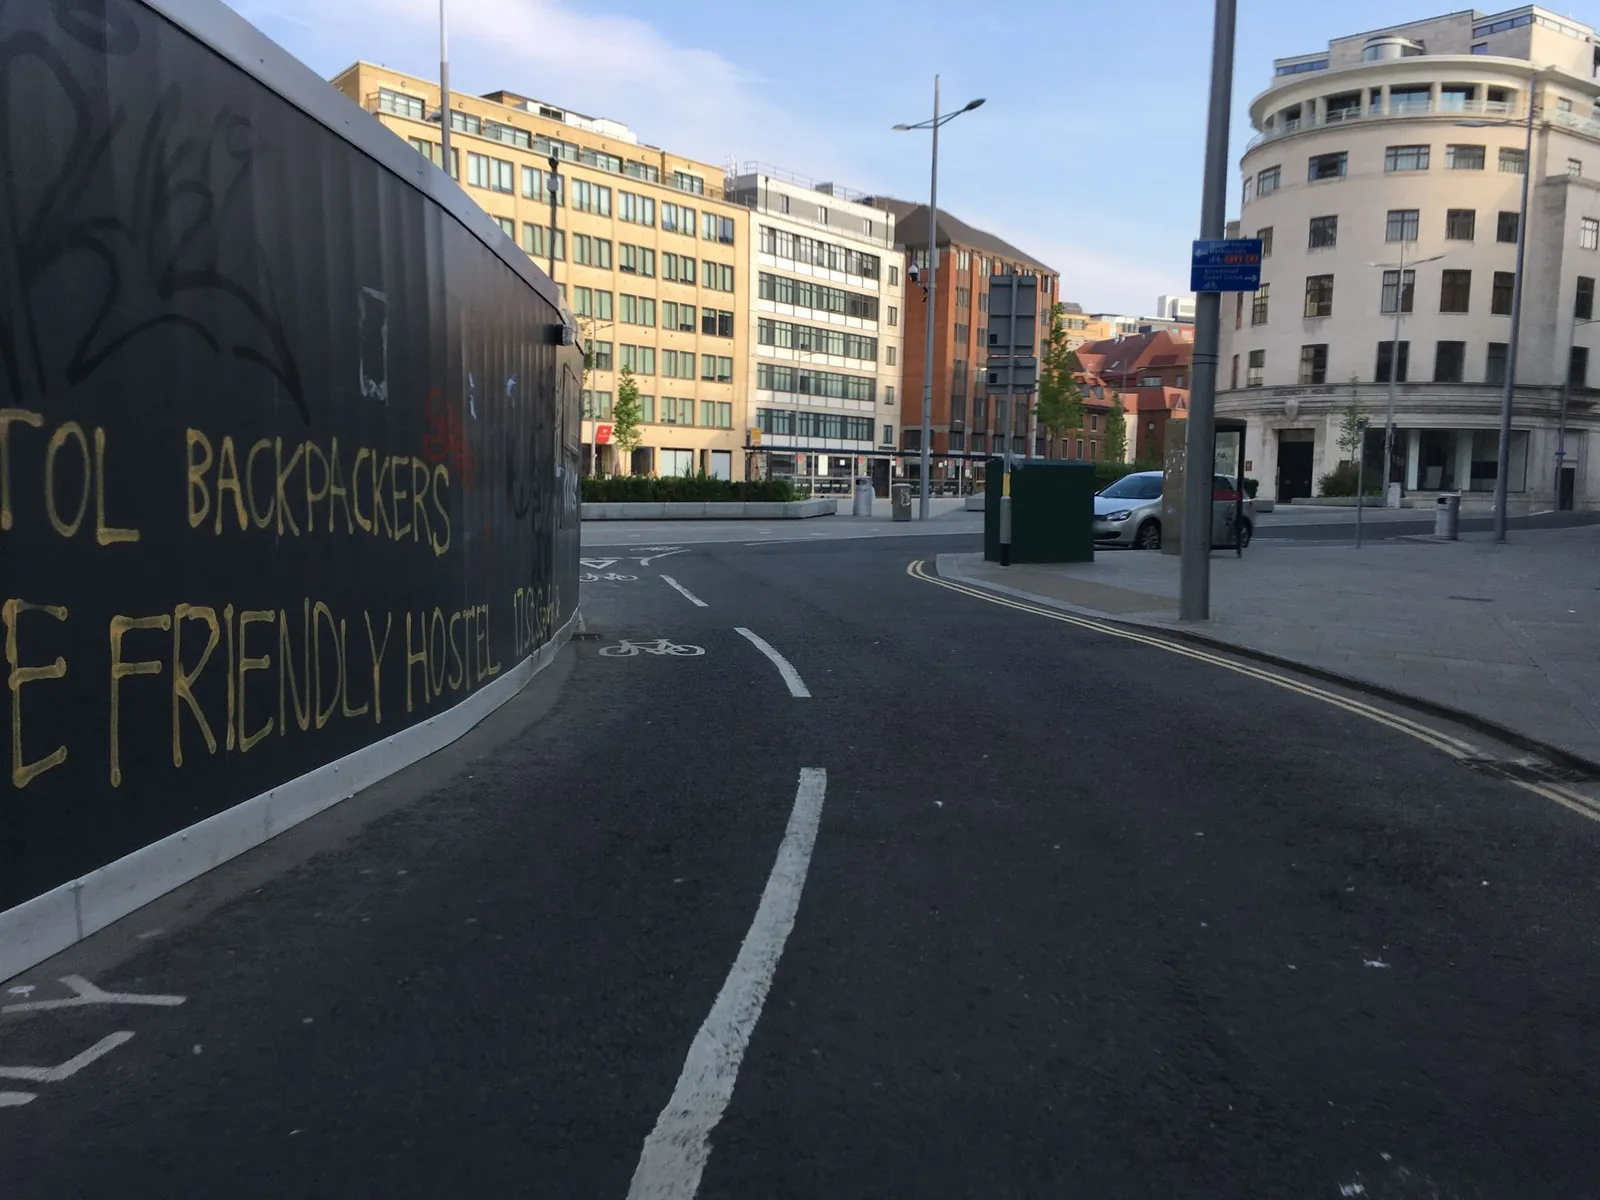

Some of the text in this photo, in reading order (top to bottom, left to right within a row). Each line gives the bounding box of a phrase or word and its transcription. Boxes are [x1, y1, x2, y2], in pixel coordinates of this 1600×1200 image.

[0, 408, 140, 546] TOL
[186, 427, 450, 557] BACKPACKERS
[109, 597, 392, 788] FRIENDLY
[405, 603, 501, 713] HOSTEL
